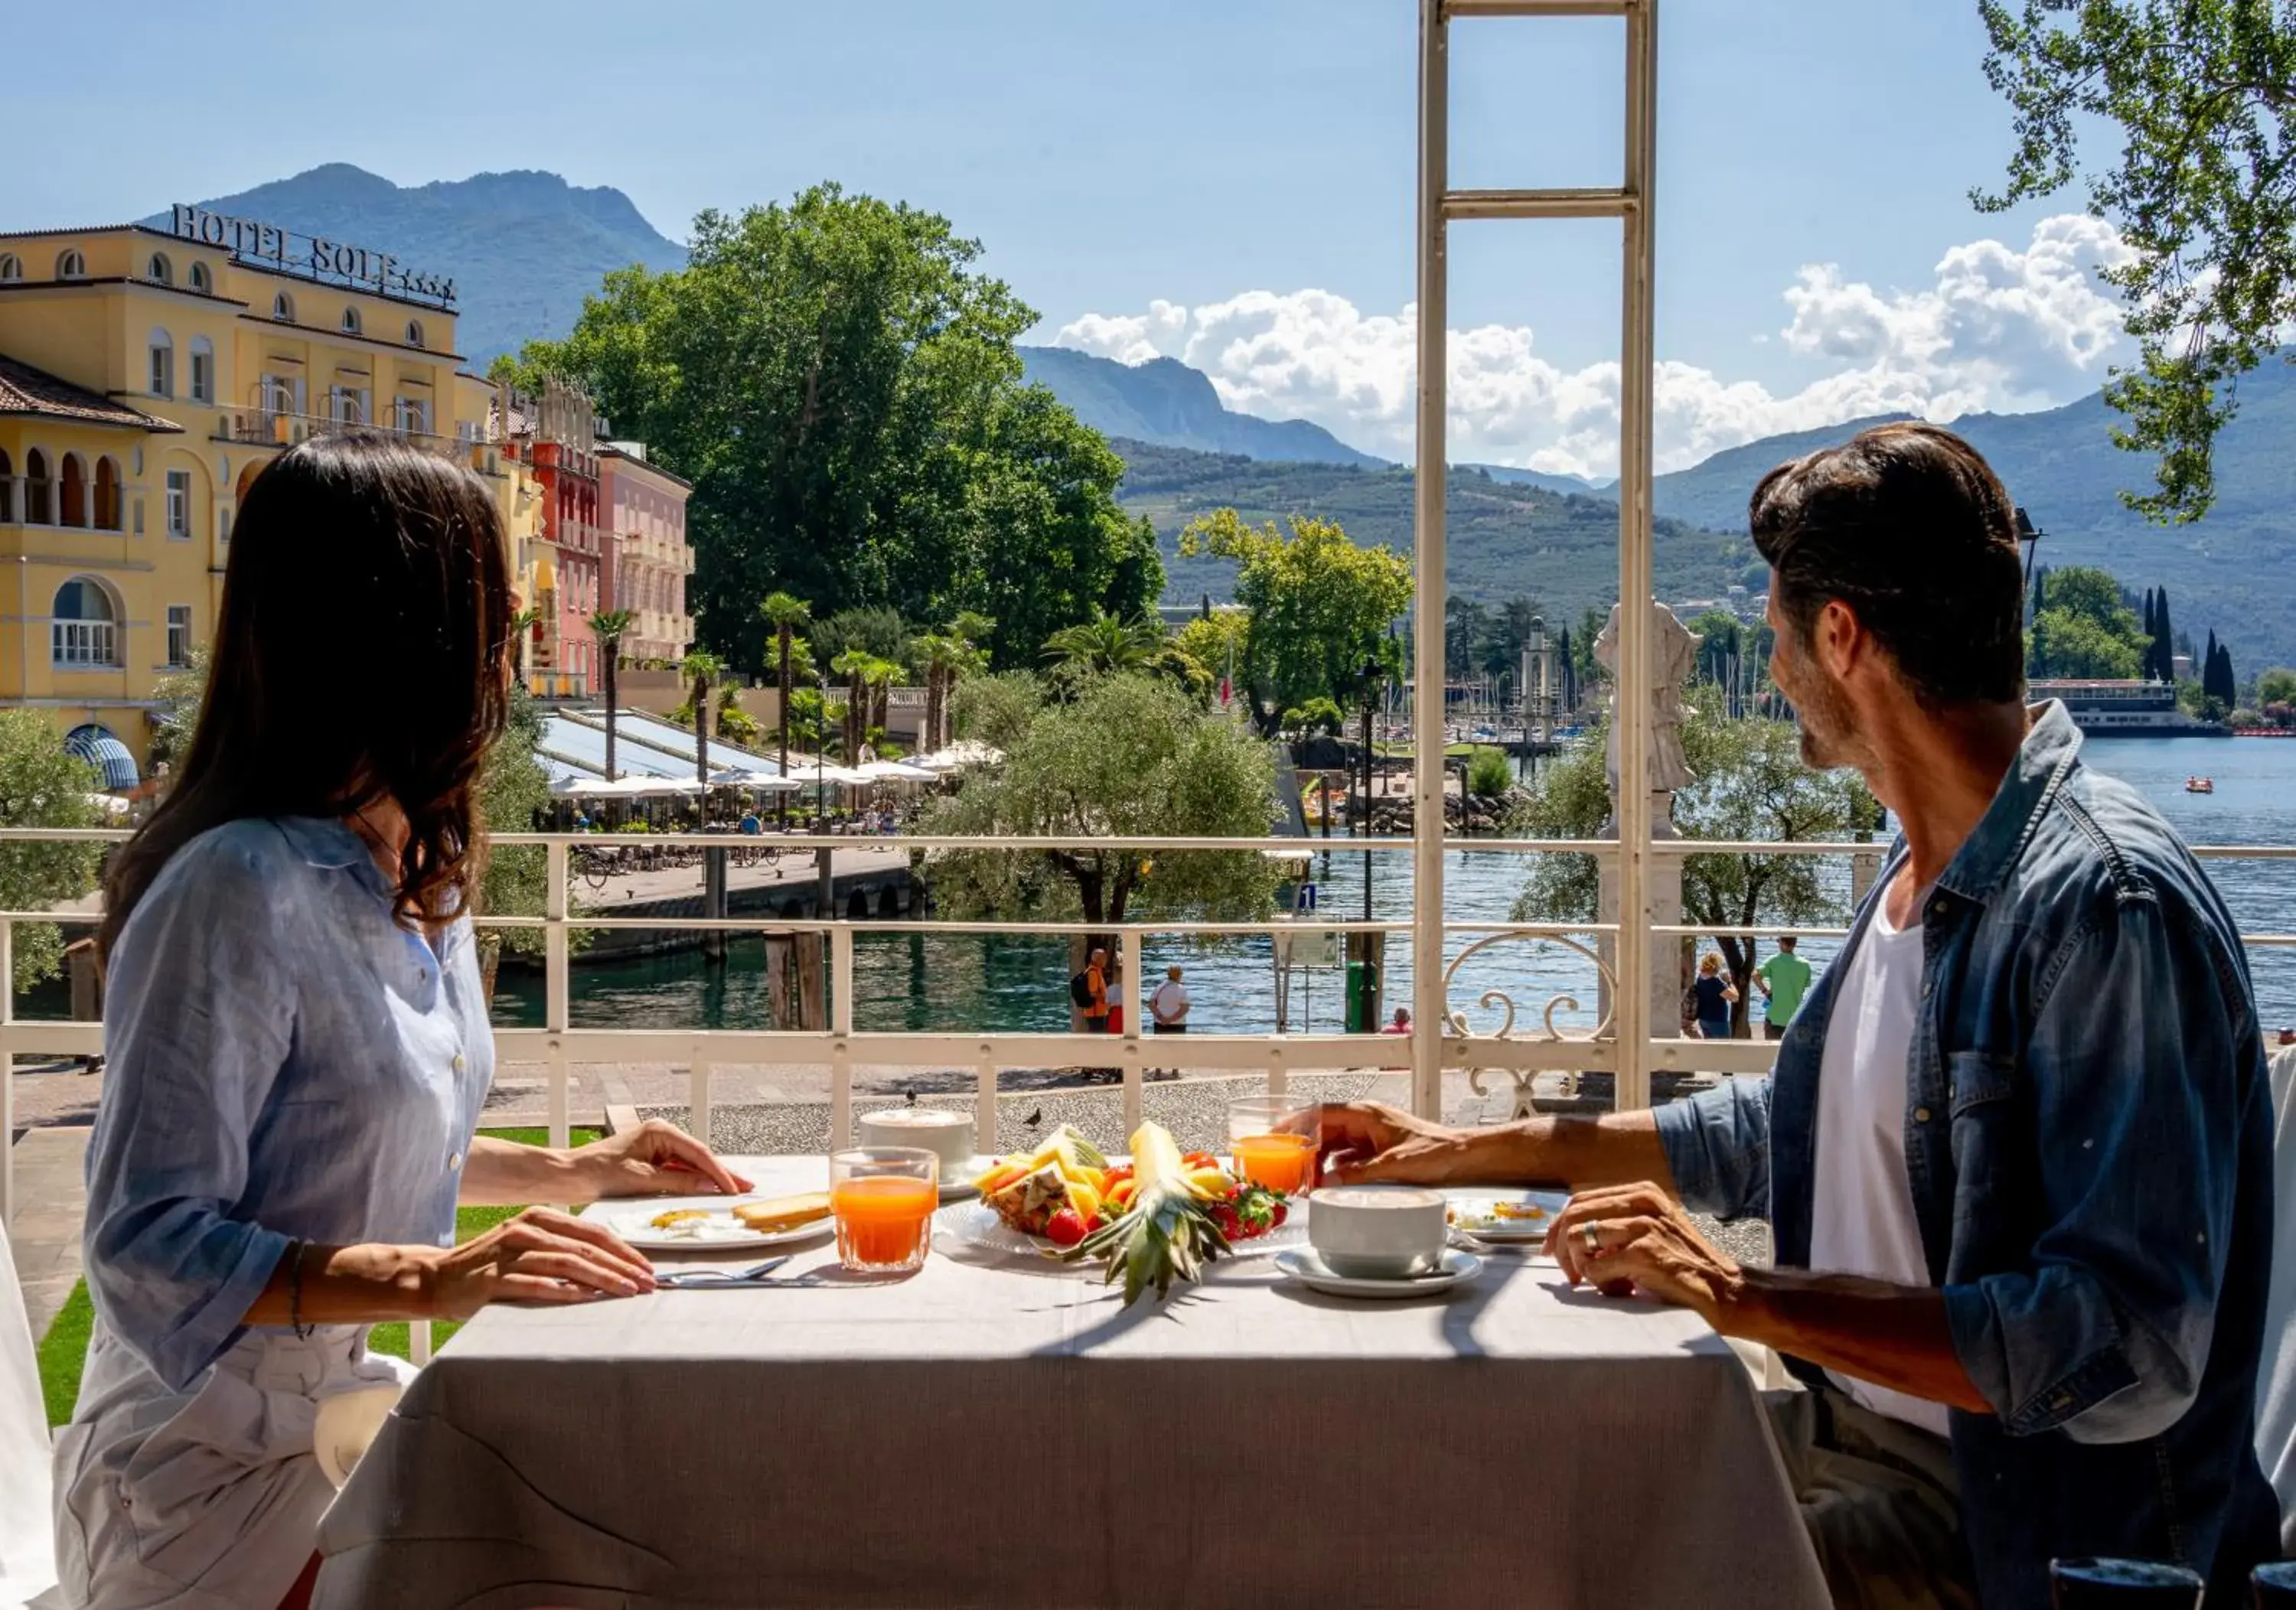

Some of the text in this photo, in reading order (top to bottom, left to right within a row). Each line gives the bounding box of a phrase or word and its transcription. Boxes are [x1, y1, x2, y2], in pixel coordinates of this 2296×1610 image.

[173, 204, 398, 288] HOTEL SOLE
[1302, 887, 1311, 909] 1
